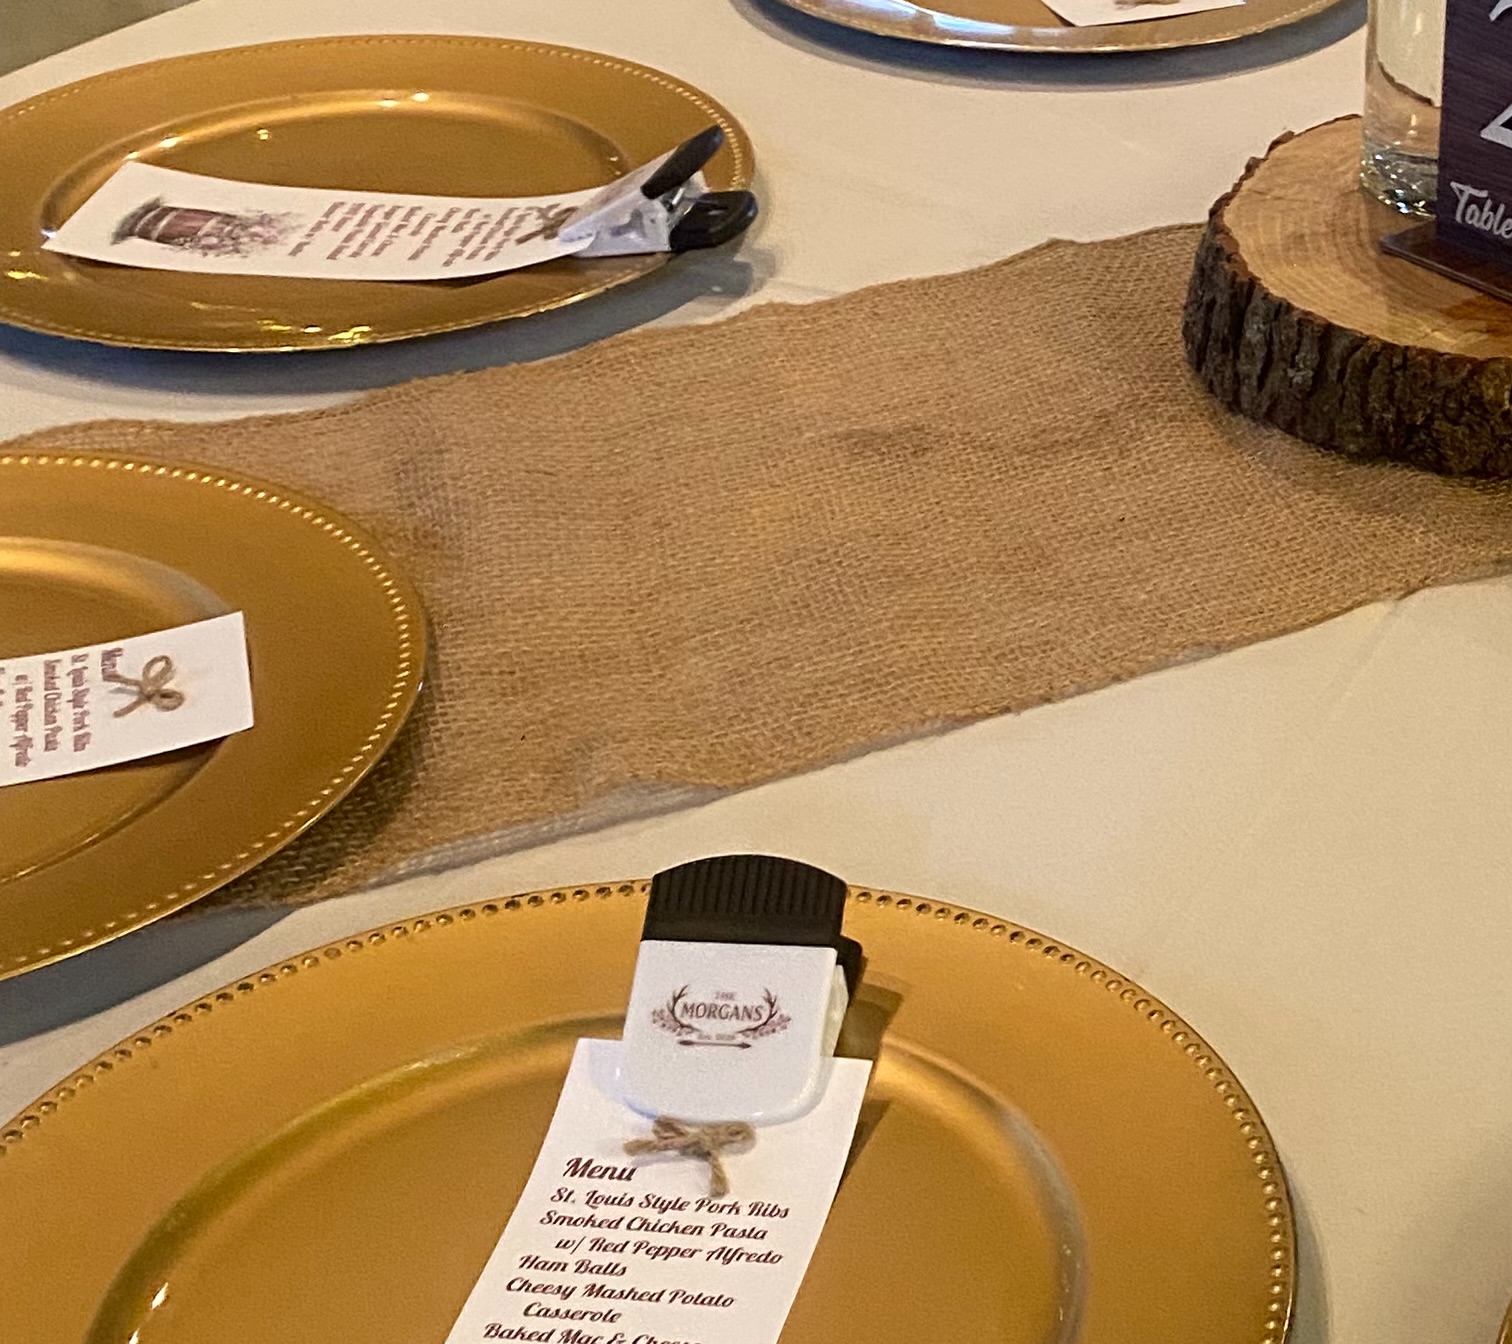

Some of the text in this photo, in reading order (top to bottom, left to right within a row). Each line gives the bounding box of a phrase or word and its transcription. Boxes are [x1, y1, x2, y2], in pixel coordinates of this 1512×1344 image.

[680, 1003, 765, 1022] MORGANS
[563, 1157, 637, 1181] Menu
[550, 1187, 790, 1219] St. Louis Style Pork Ribs
[540, 1210, 768, 1241] Smoked Chicken Pasta
[589, 1237, 630, 1254] Red
[633, 1240, 703, 1262] Pepper
[706, 1245, 784, 1266] Alfredo
[519, 1254, 628, 1277] Ham Balls
[506, 1277, 736, 1308] Cheesy Mashed Potato
[523, 1301, 623, 1324] Casserole
[483, 1322, 552, 1344] Baked
